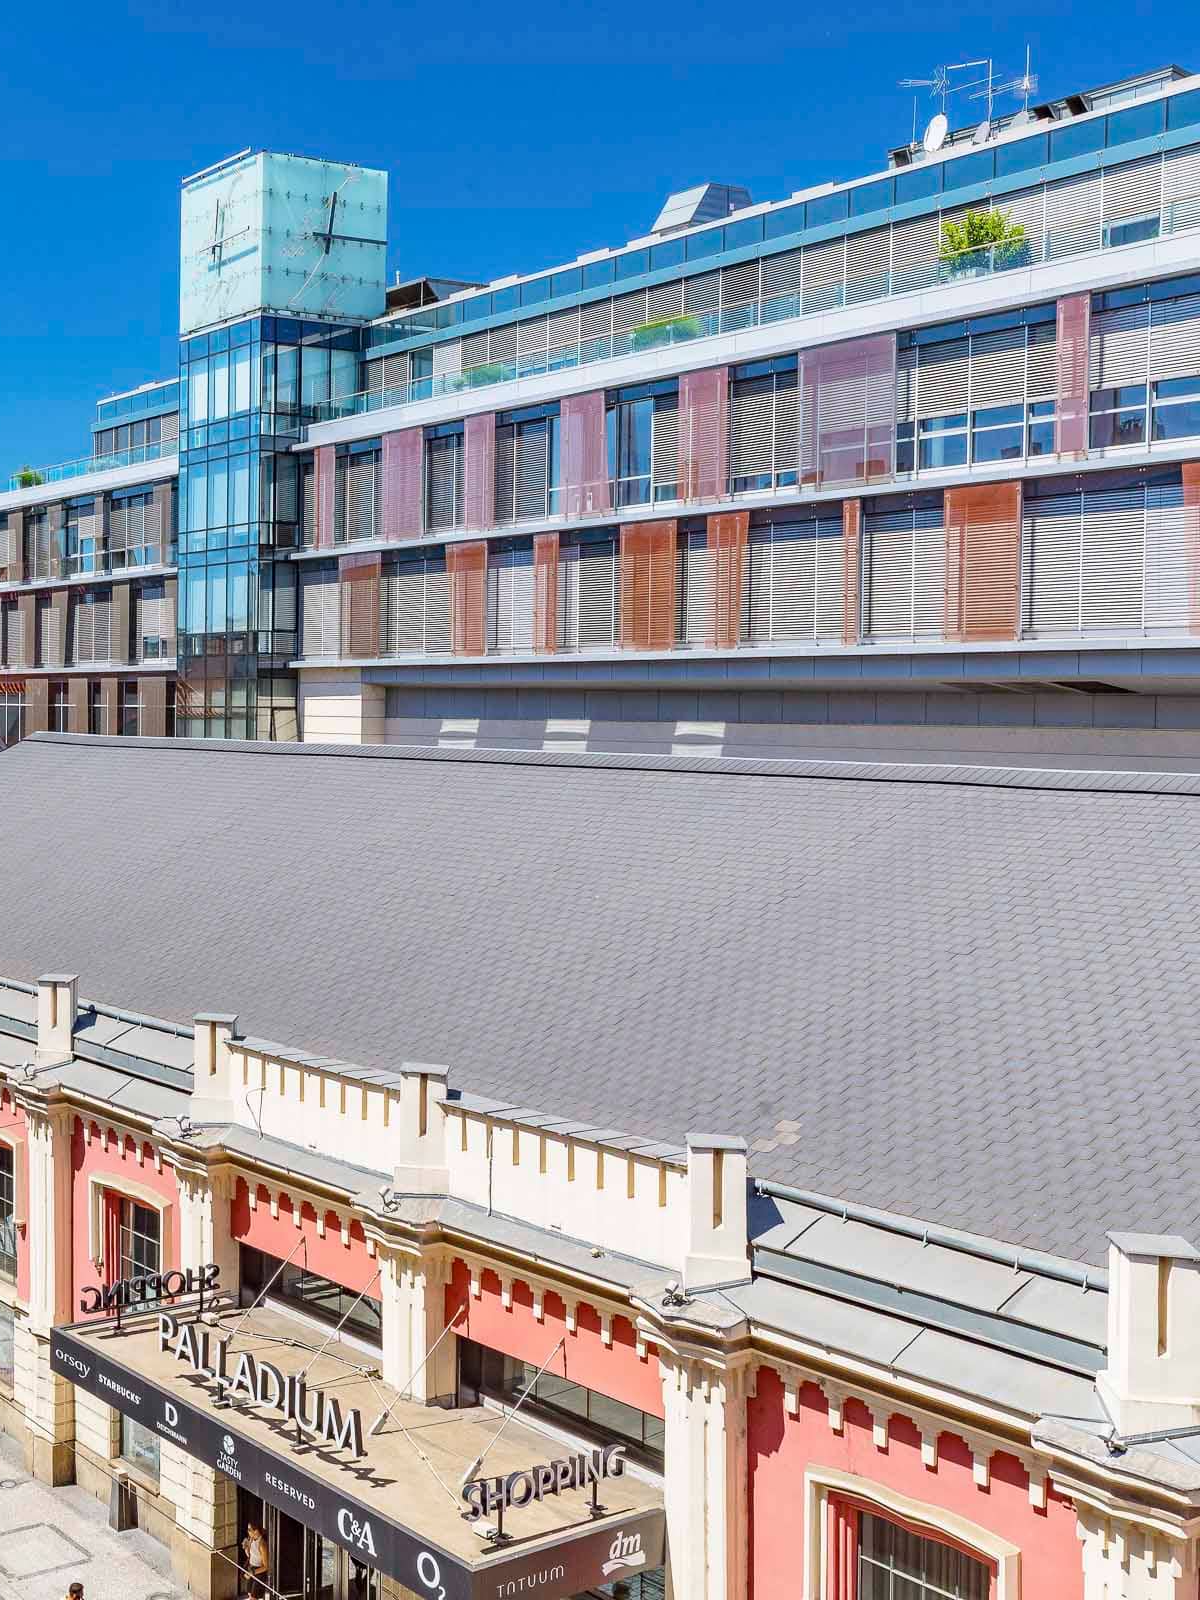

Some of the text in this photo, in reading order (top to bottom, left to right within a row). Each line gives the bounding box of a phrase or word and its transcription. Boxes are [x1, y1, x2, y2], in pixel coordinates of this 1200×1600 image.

[55, 1348, 91, 1379] orsay
[98, 1373, 141, 1405] STARBUCKS
[159, 1312, 367, 1458] PALLADIUM
[216, 1458, 242, 1481] GARDEN
[220, 1450, 239, 1469] TASTY
[265, 1471, 316, 1510] RESERVED
[462, 1444, 626, 1522] SHOPPING
[337, 1508, 378, 1557] C&A
[608, 1531, 642, 1561] dm
